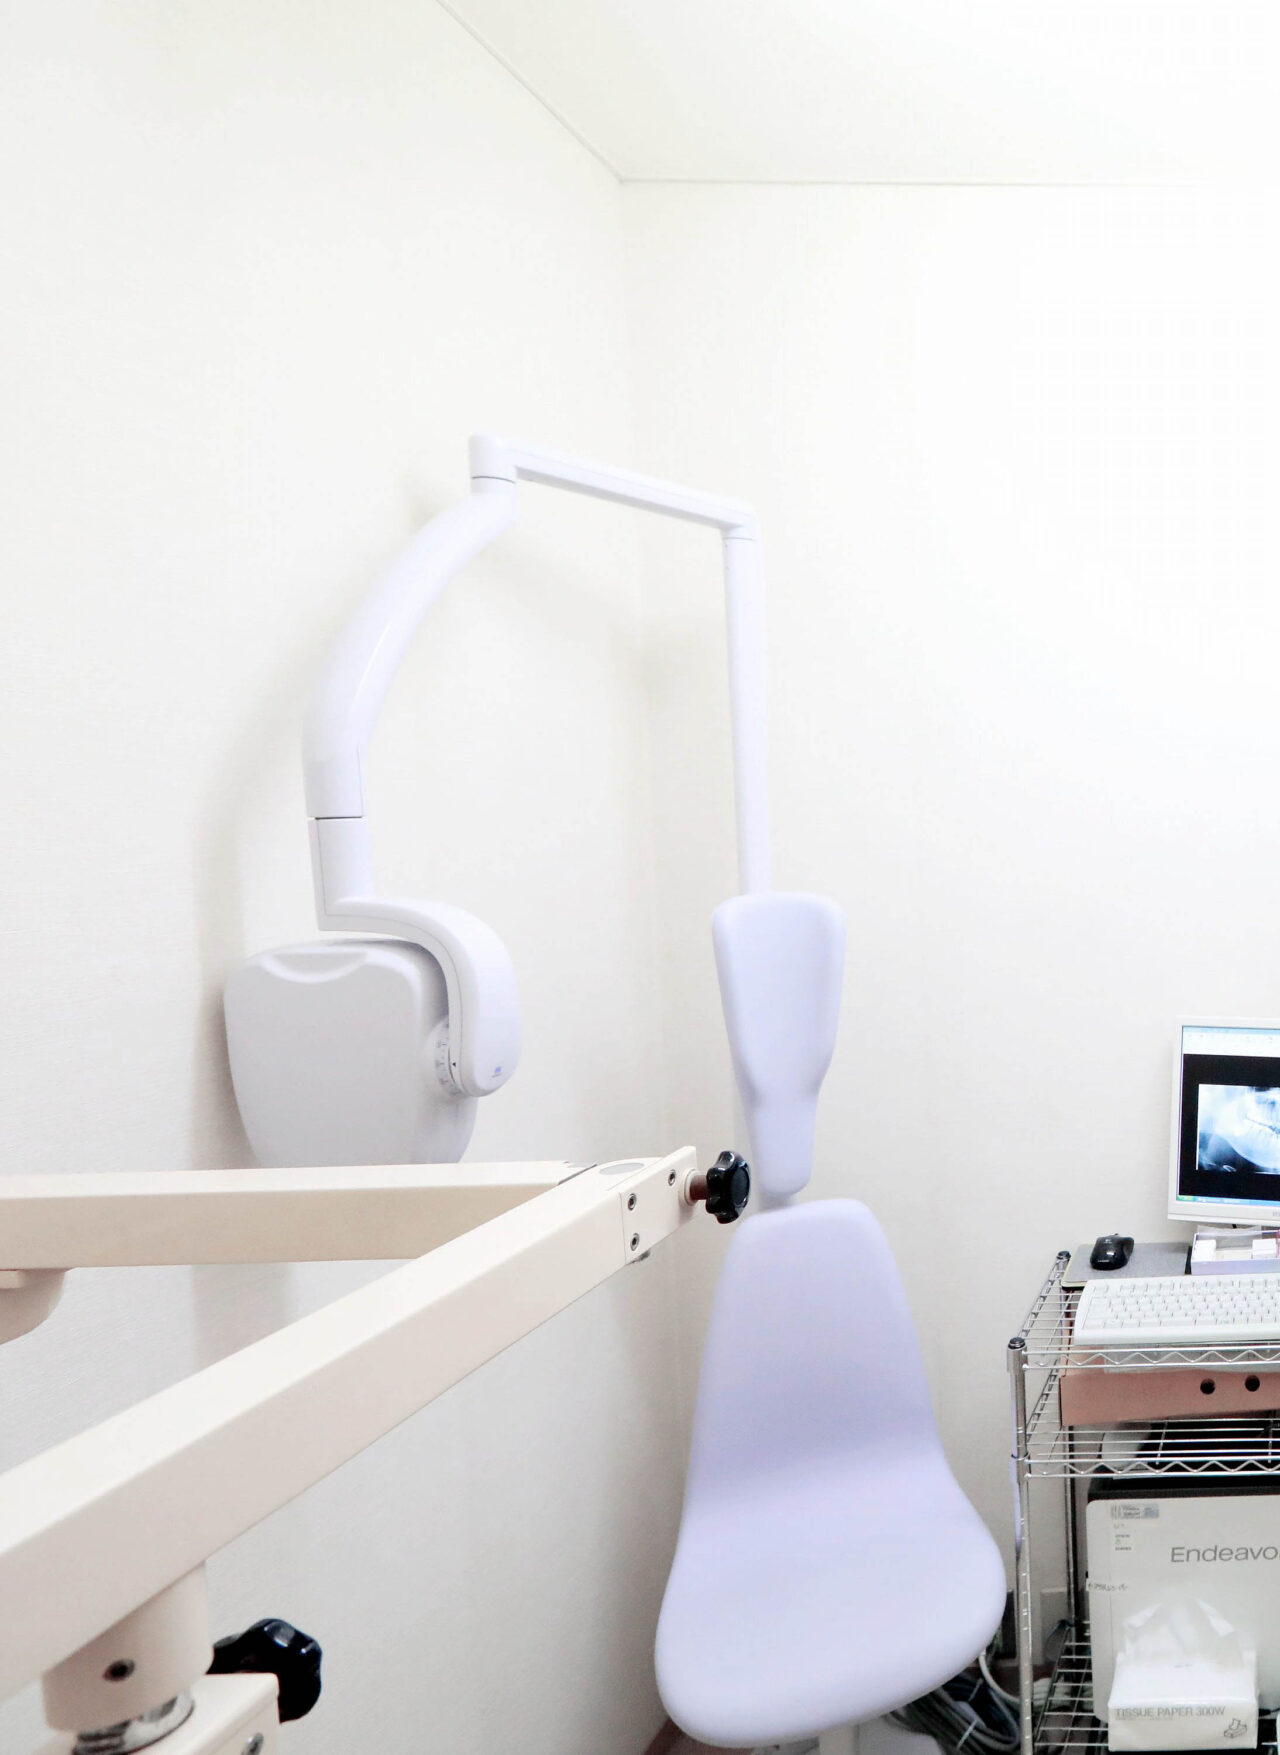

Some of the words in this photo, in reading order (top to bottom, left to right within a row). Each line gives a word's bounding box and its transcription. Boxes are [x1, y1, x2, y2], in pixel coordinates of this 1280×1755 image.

[1116, 1706, 1154, 1718] TISSUE
[1156, 1706, 1193, 1717] PAPER
[1195, 1705, 1225, 1717] 300W
